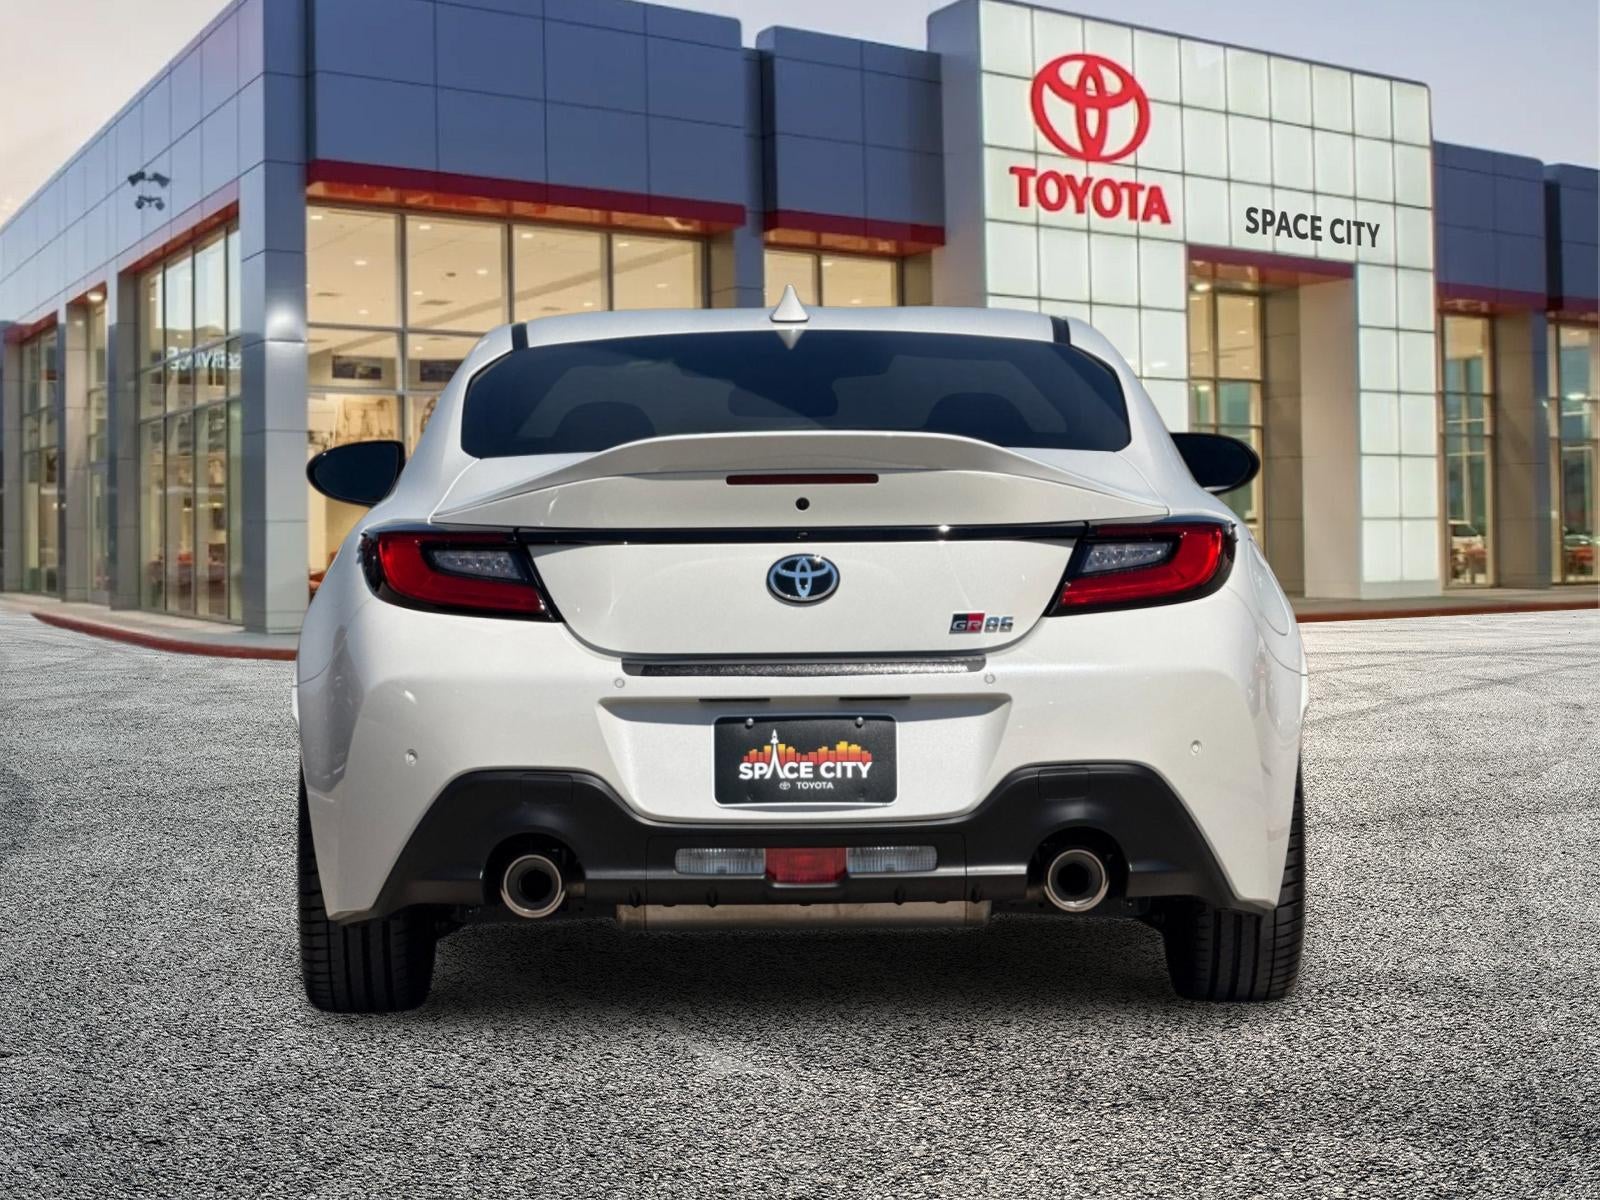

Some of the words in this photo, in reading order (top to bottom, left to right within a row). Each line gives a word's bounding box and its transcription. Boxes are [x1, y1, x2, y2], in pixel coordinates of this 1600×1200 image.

[1009, 166, 1171, 225] TOYOTA
[1245, 206, 1323, 242] SPACE
[1329, 218, 1381, 248] CITY
[738, 761, 814, 780] SPACE
[819, 761, 873, 779] CITY
[796, 781, 835, 790] TOYOTA
